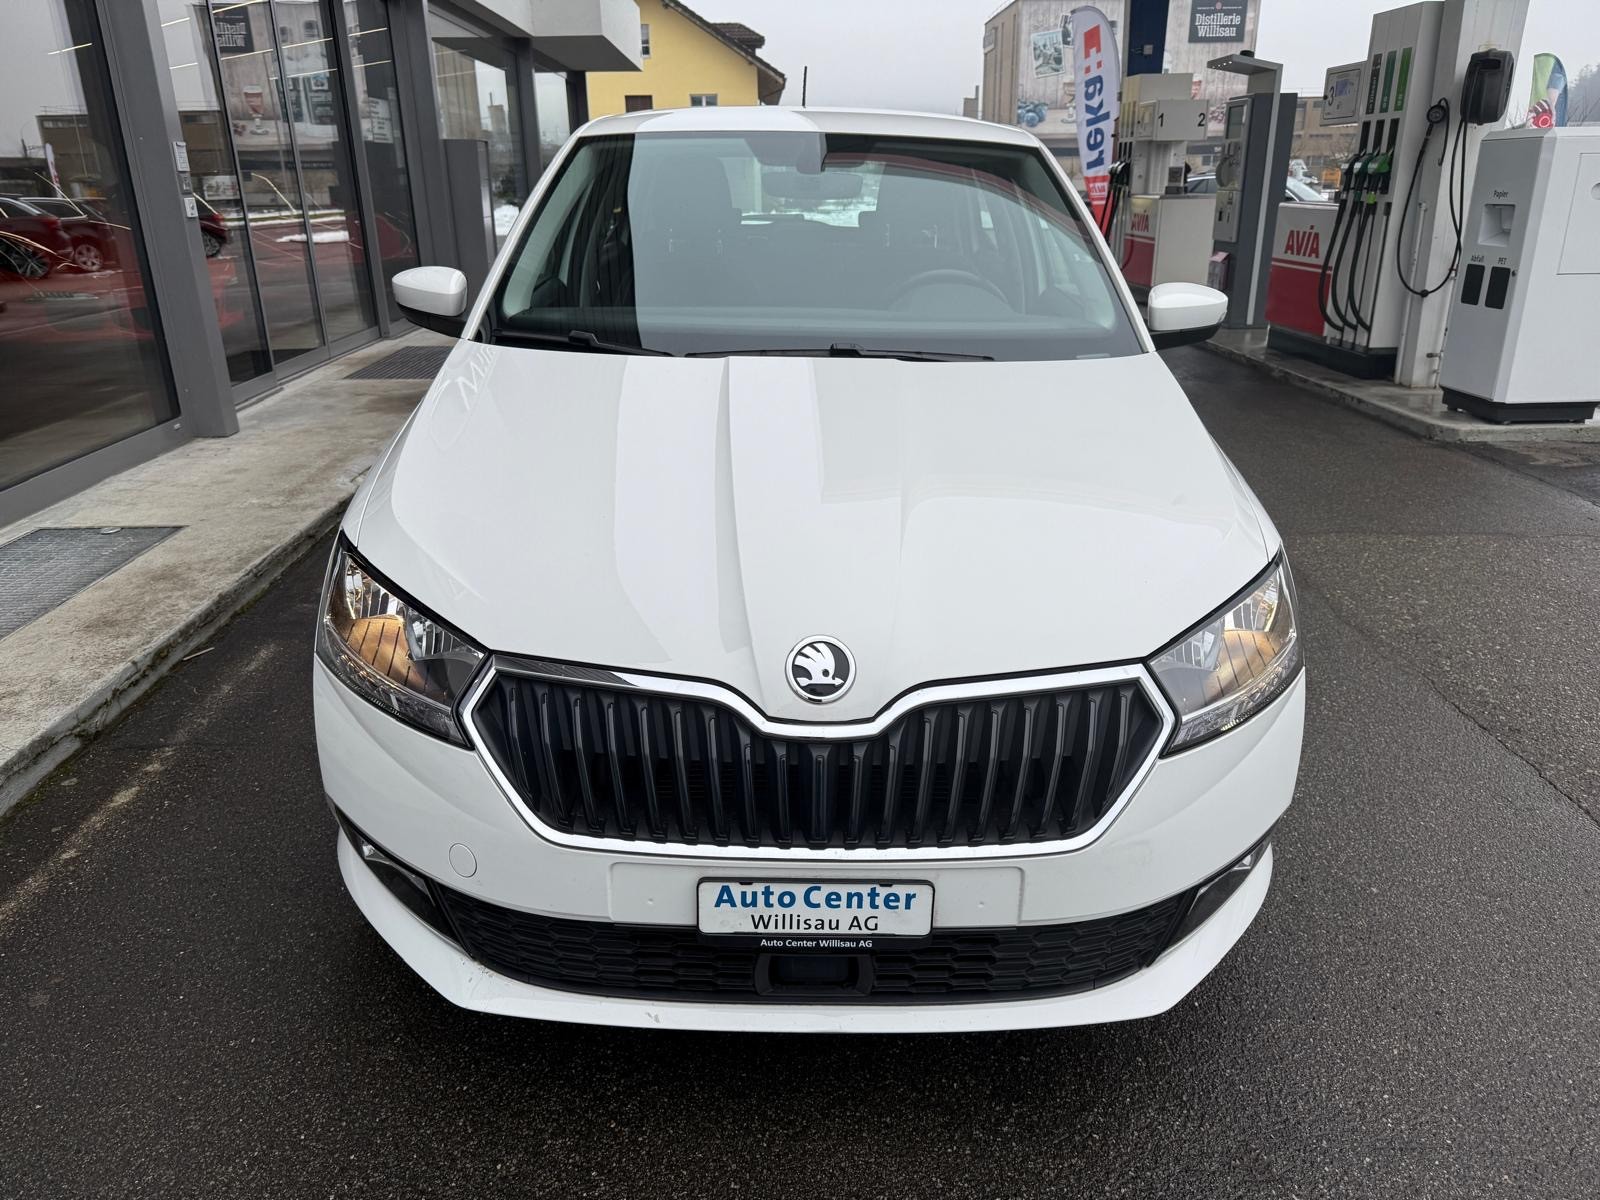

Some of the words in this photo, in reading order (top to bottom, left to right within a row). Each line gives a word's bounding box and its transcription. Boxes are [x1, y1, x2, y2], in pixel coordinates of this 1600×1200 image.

[1195, 12, 1241, 26] Distillerie
[1197, 25, 1237, 37] Willisau
[1158, 112, 1164, 127] 1
[1197, 112, 1206, 127] 2
[714, 885, 797, 908] Auto
[803, 885, 917, 910] Center
[751, 914, 840, 931] Willisau
[848, 915, 879, 931] AG
[760, 939, 783, 947] Auto
[785, 939, 817, 948] Center
[819, 939, 857, 948] Willisau
[858, 940, 873, 948] AG
